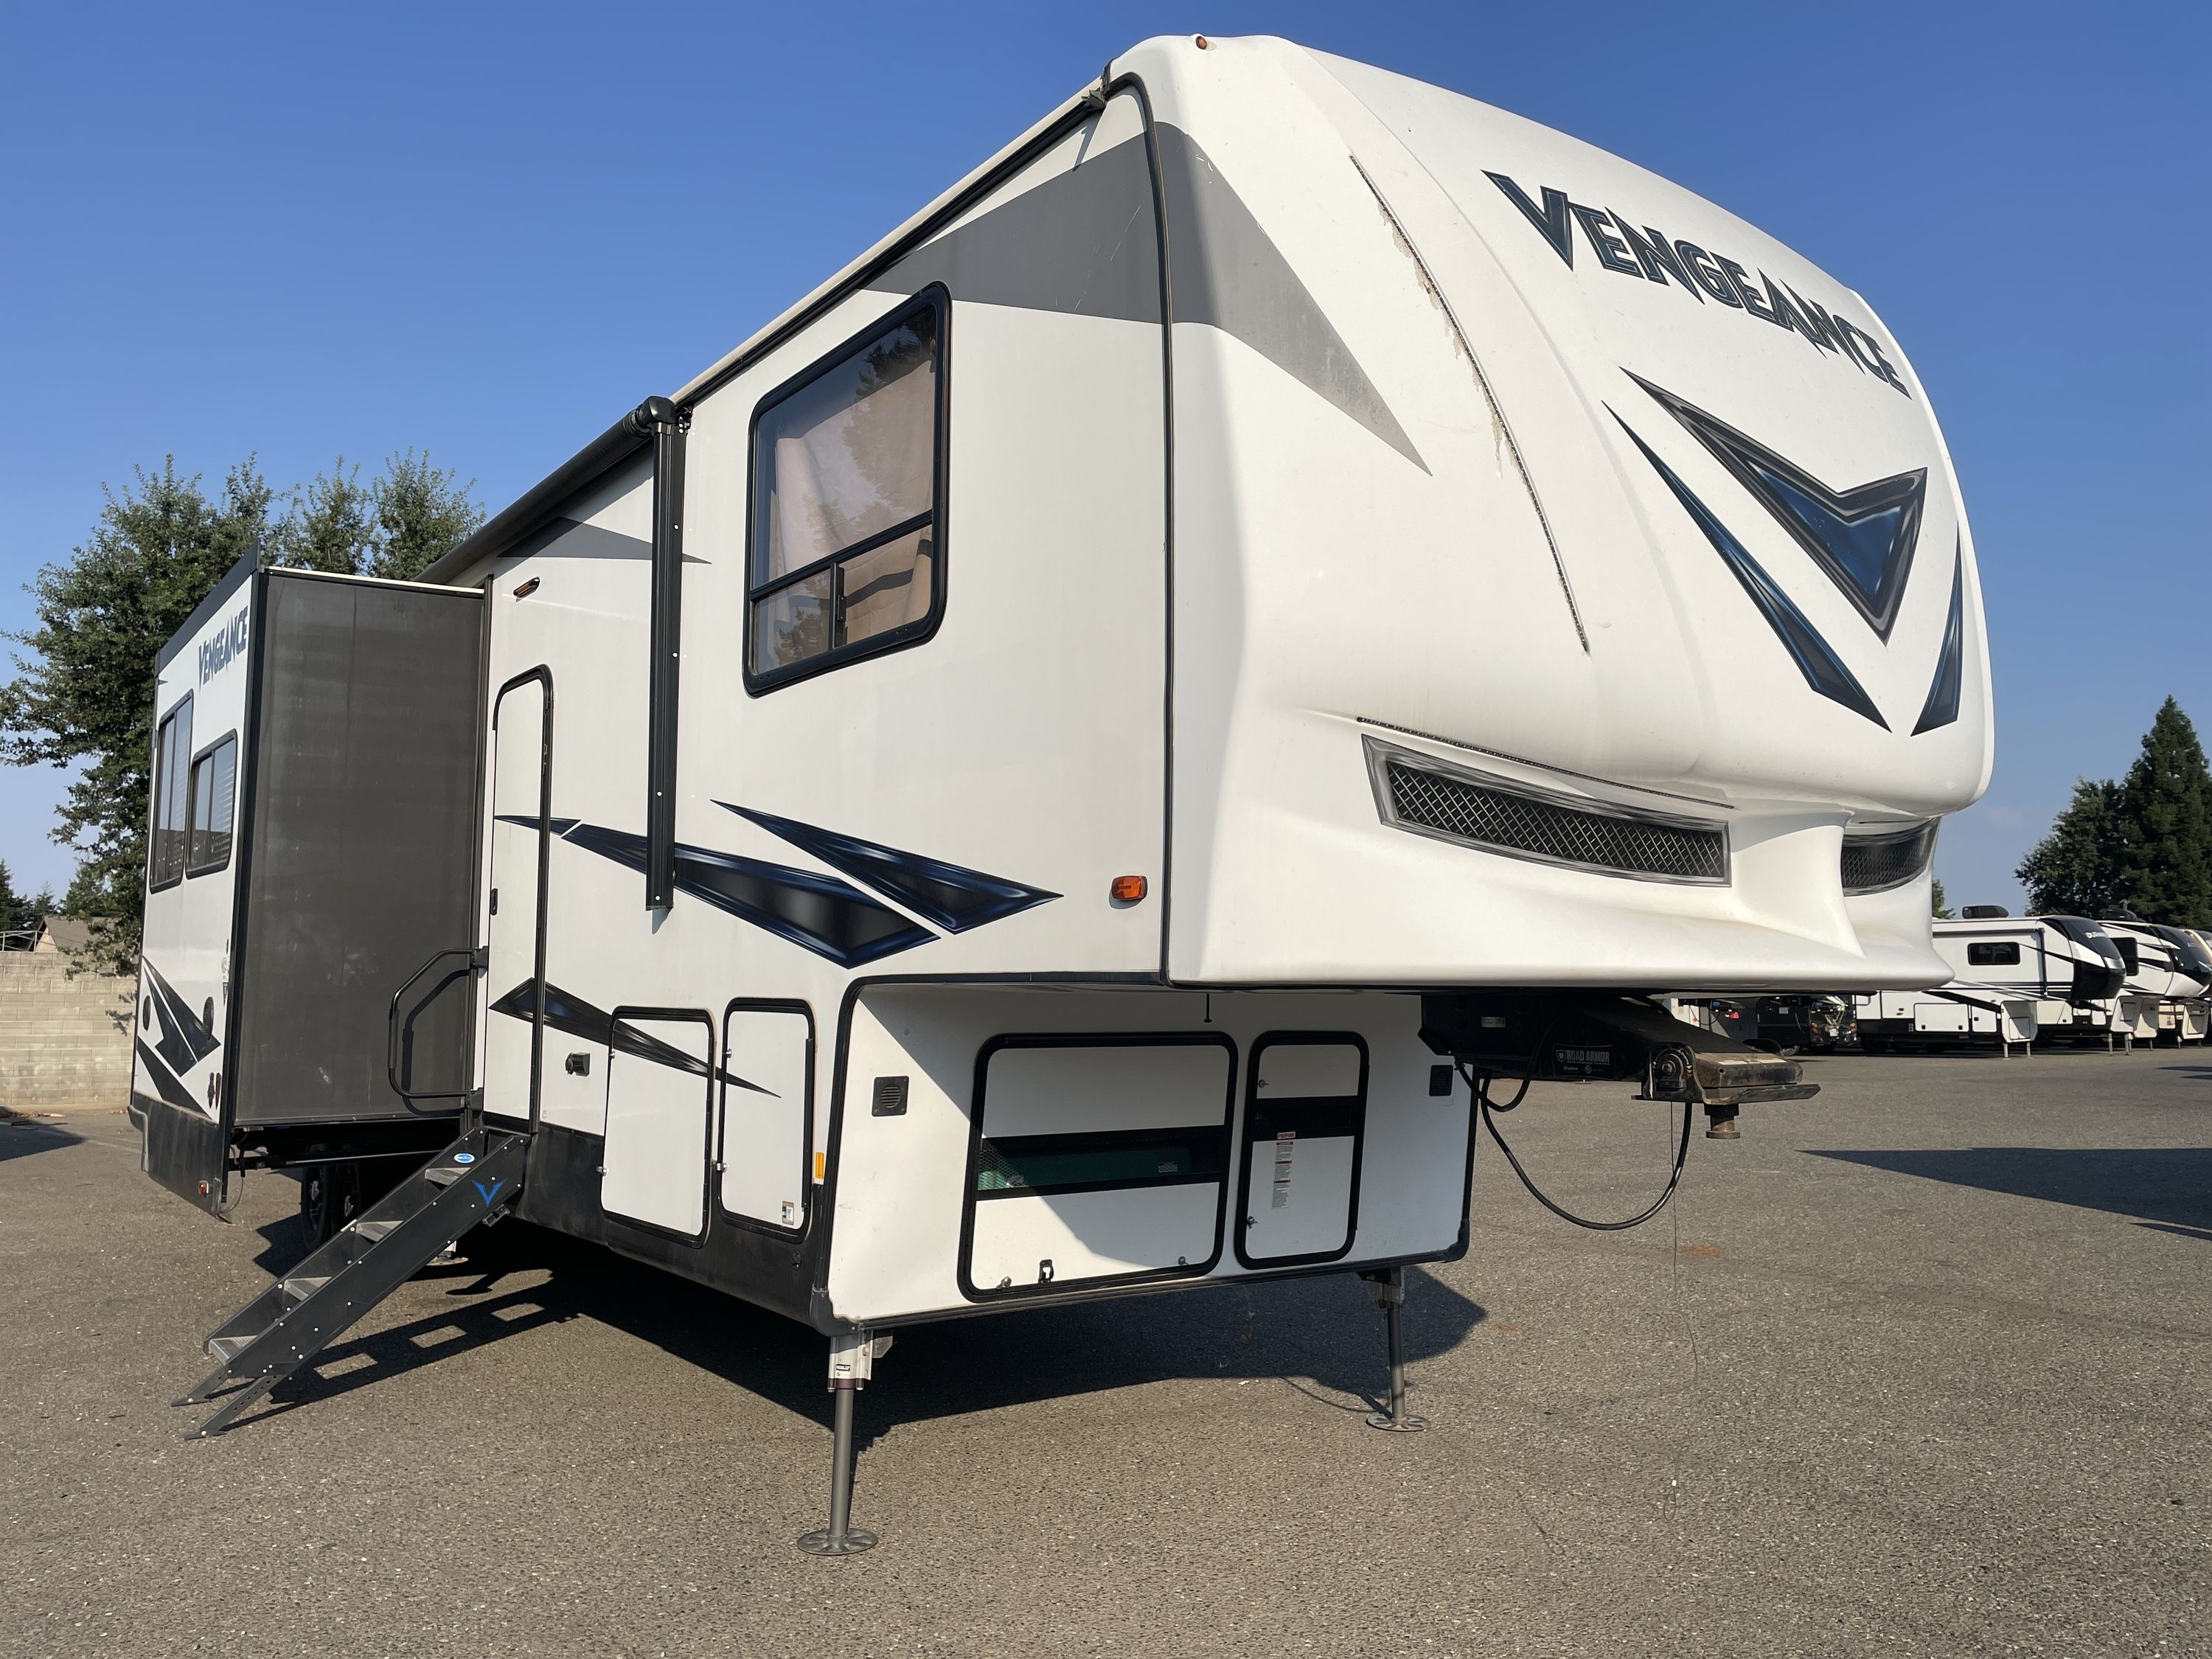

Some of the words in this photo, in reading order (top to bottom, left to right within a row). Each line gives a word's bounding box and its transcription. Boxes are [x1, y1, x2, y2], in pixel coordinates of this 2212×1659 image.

[1481, 170, 1912, 400] VENGEANCE
[198, 605, 248, 693] VENGEANCE
[1567, 1050, 1585, 1062] ROAD
[1586, 1051, 1610, 1062] ARMOR
